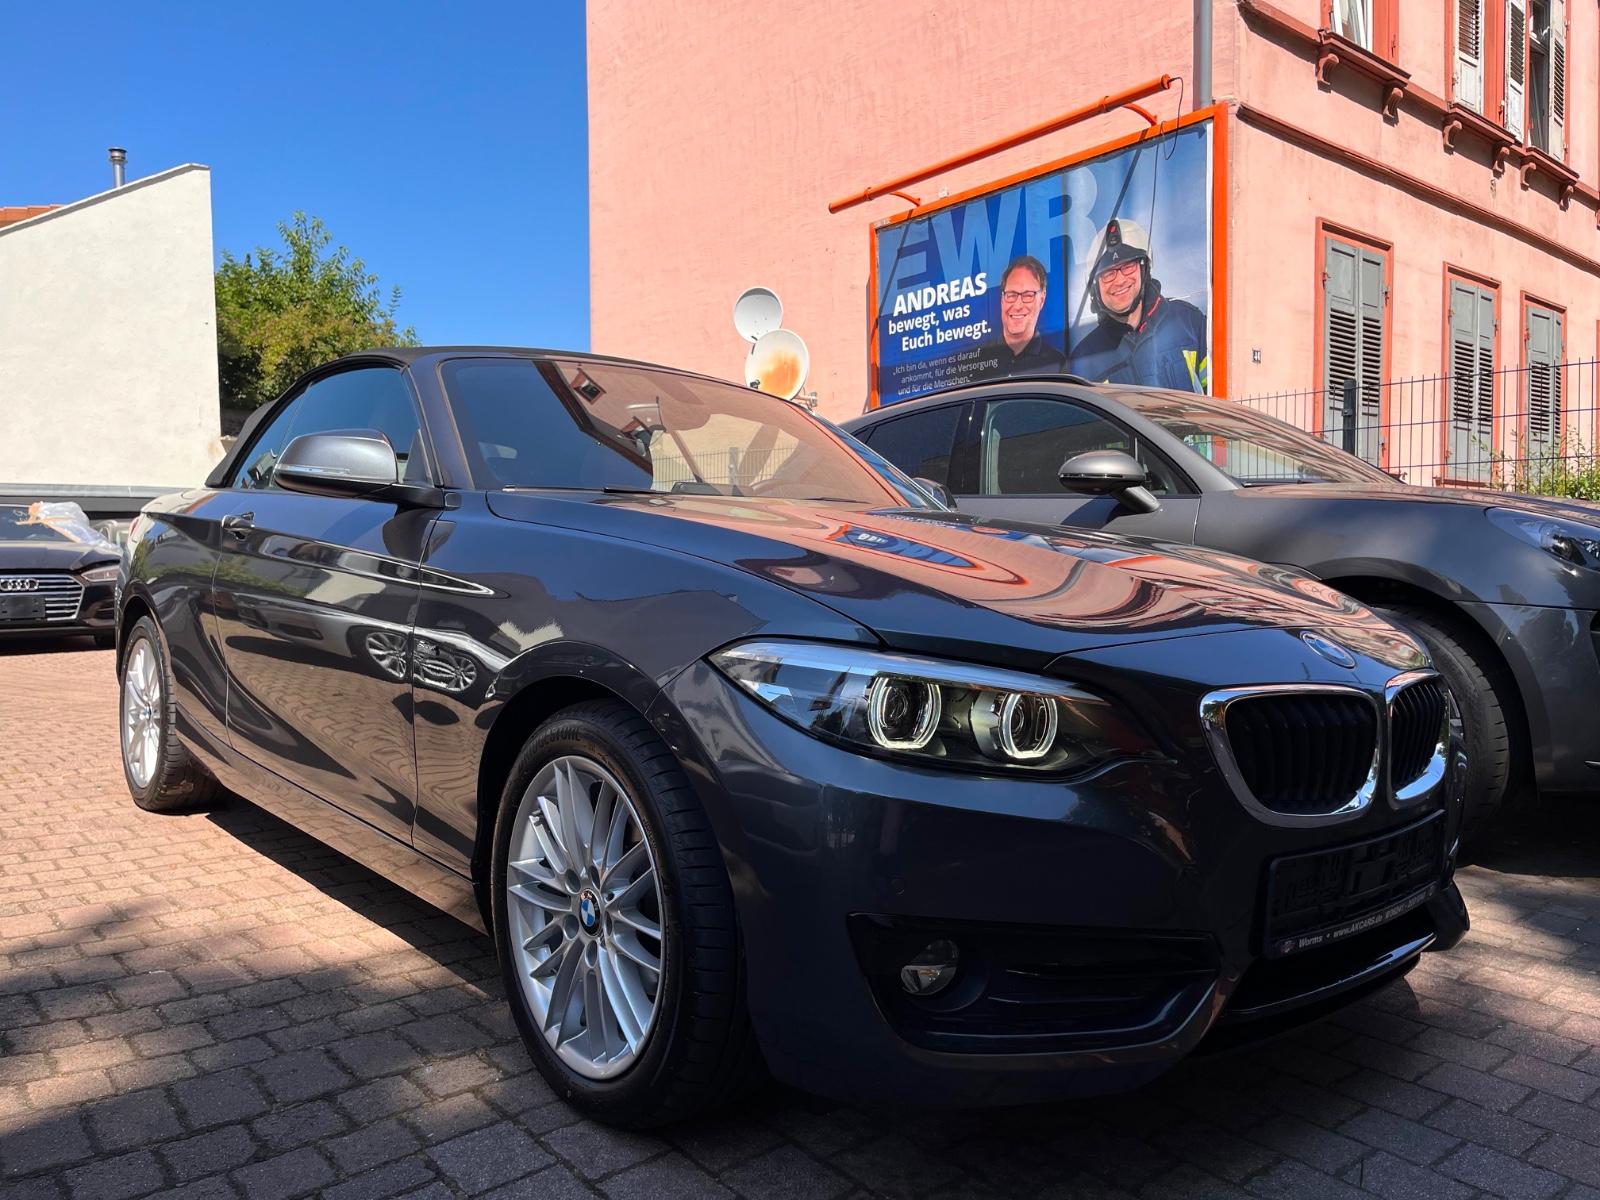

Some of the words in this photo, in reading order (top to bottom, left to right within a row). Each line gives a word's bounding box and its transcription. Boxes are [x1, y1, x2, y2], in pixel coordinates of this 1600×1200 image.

[878, 165, 1098, 316] EWR
[893, 272, 987, 317] ANDREAS
[889, 312, 939, 335] bewegt,
[943, 304, 970, 322] was
[902, 332, 932, 351] Euch
[936, 320, 991, 344] bewegt.
[906, 362, 917, 373] bin
[929, 357, 947, 367] wenn
[948, 355, 957, 363] es
[957, 348, 981, 361] darauf
[934, 367, 944, 377] für
[946, 363, 957, 374] die
[958, 358, 998, 371] Versorgung
[897, 385, 911, 396] und
[922, 379, 933, 390] die
[1299, 935, 1323, 948] Worms
